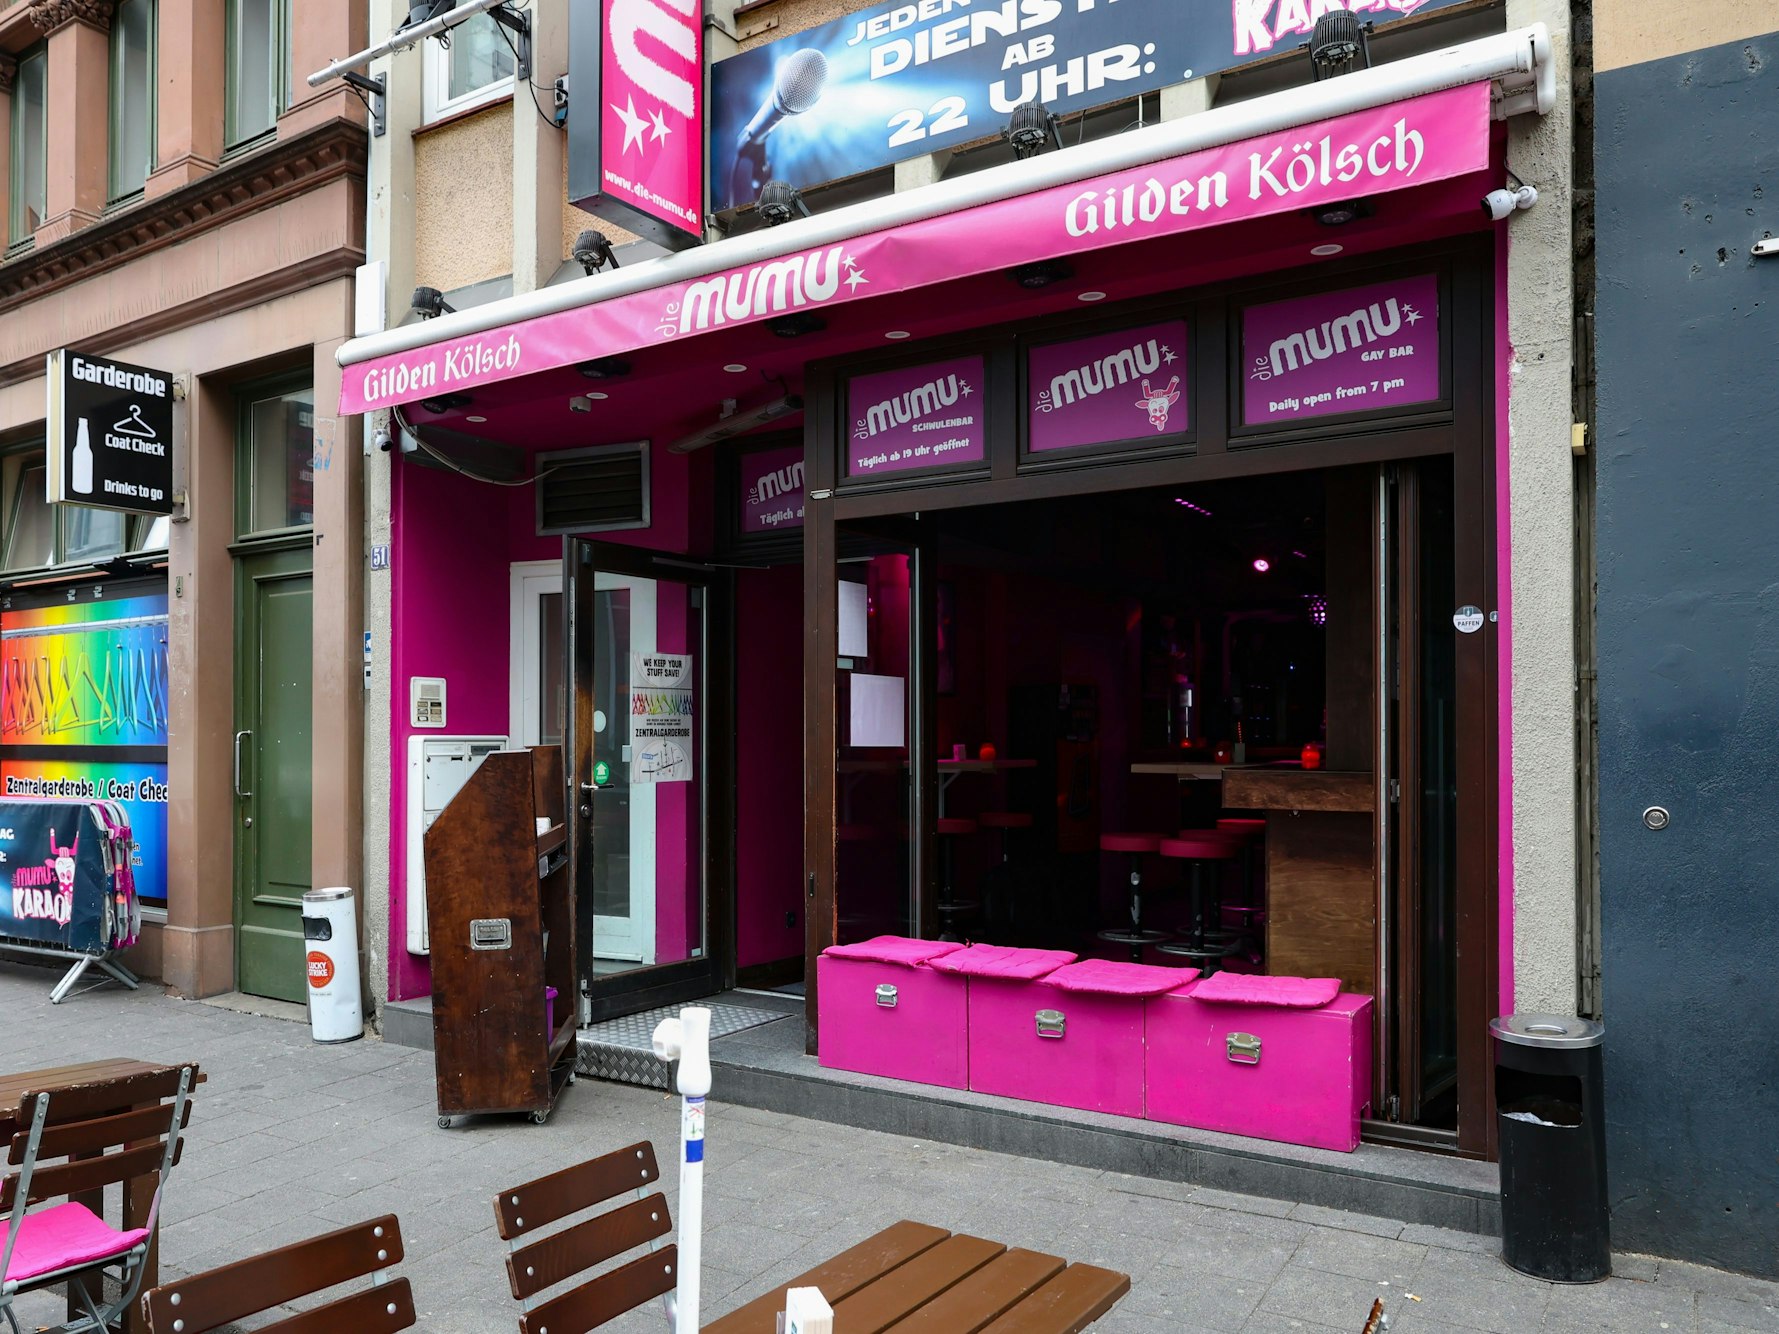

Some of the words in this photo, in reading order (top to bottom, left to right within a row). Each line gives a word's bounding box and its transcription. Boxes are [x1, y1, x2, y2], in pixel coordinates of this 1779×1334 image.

[870, 0, 1119, 81] DIENS
[1001, 34, 1055, 70] AB
[989, 42, 1157, 114] UHR:
[887, 96, 969, 149] 22
[1064, 171, 1230, 237] Gilden
[1248, 118, 1424, 200] Kölsch
[605, 170, 697, 225] www.die-mumu.de
[1361, 349, 1385, 362] GAY
[1389, 345, 1414, 358] BAR
[72, 357, 165, 397] Garderobe
[363, 360, 436, 402] Gilden
[443, 334, 521, 383] Kölsch
[1269, 397, 1299, 412] Daily
[1303, 392, 1332, 407] open
[1336, 385, 1366, 399] from
[1370, 381, 1379, 392] 7
[1383, 378, 1405, 392] pm
[912, 416, 974, 432] SCHWULENBAR
[105, 433, 131, 449] Coat
[132, 438, 165, 456] Check
[858, 453, 887, 468] Täglich
[890, 450, 900, 461] ab
[903, 449, 912, 458] 19
[914, 445, 930, 456] Uhr
[933, 438, 970, 455] geöffnet
[104, 479, 137, 497] Drinks
[138, 484, 149, 498] to
[150, 488, 163, 501] go
[760, 507, 793, 526] Täglich
[373, 547, 386, 566] 51
[643, 658, 652, 667] WE
[654, 659, 667, 668] KEEP
[669, 660, 682, 669] YOUR
[647, 668, 663, 677] STUFF
[665, 668, 680, 678] SAVE!
[635, 728, 690, 738] ZENTRALGARDEROBE
[6, 776, 94, 798] Zentralgarderobe
[108, 778, 135, 799] Coat
[309, 961, 327, 969] LUCKY
[309, 969, 328, 977] STRIKE
